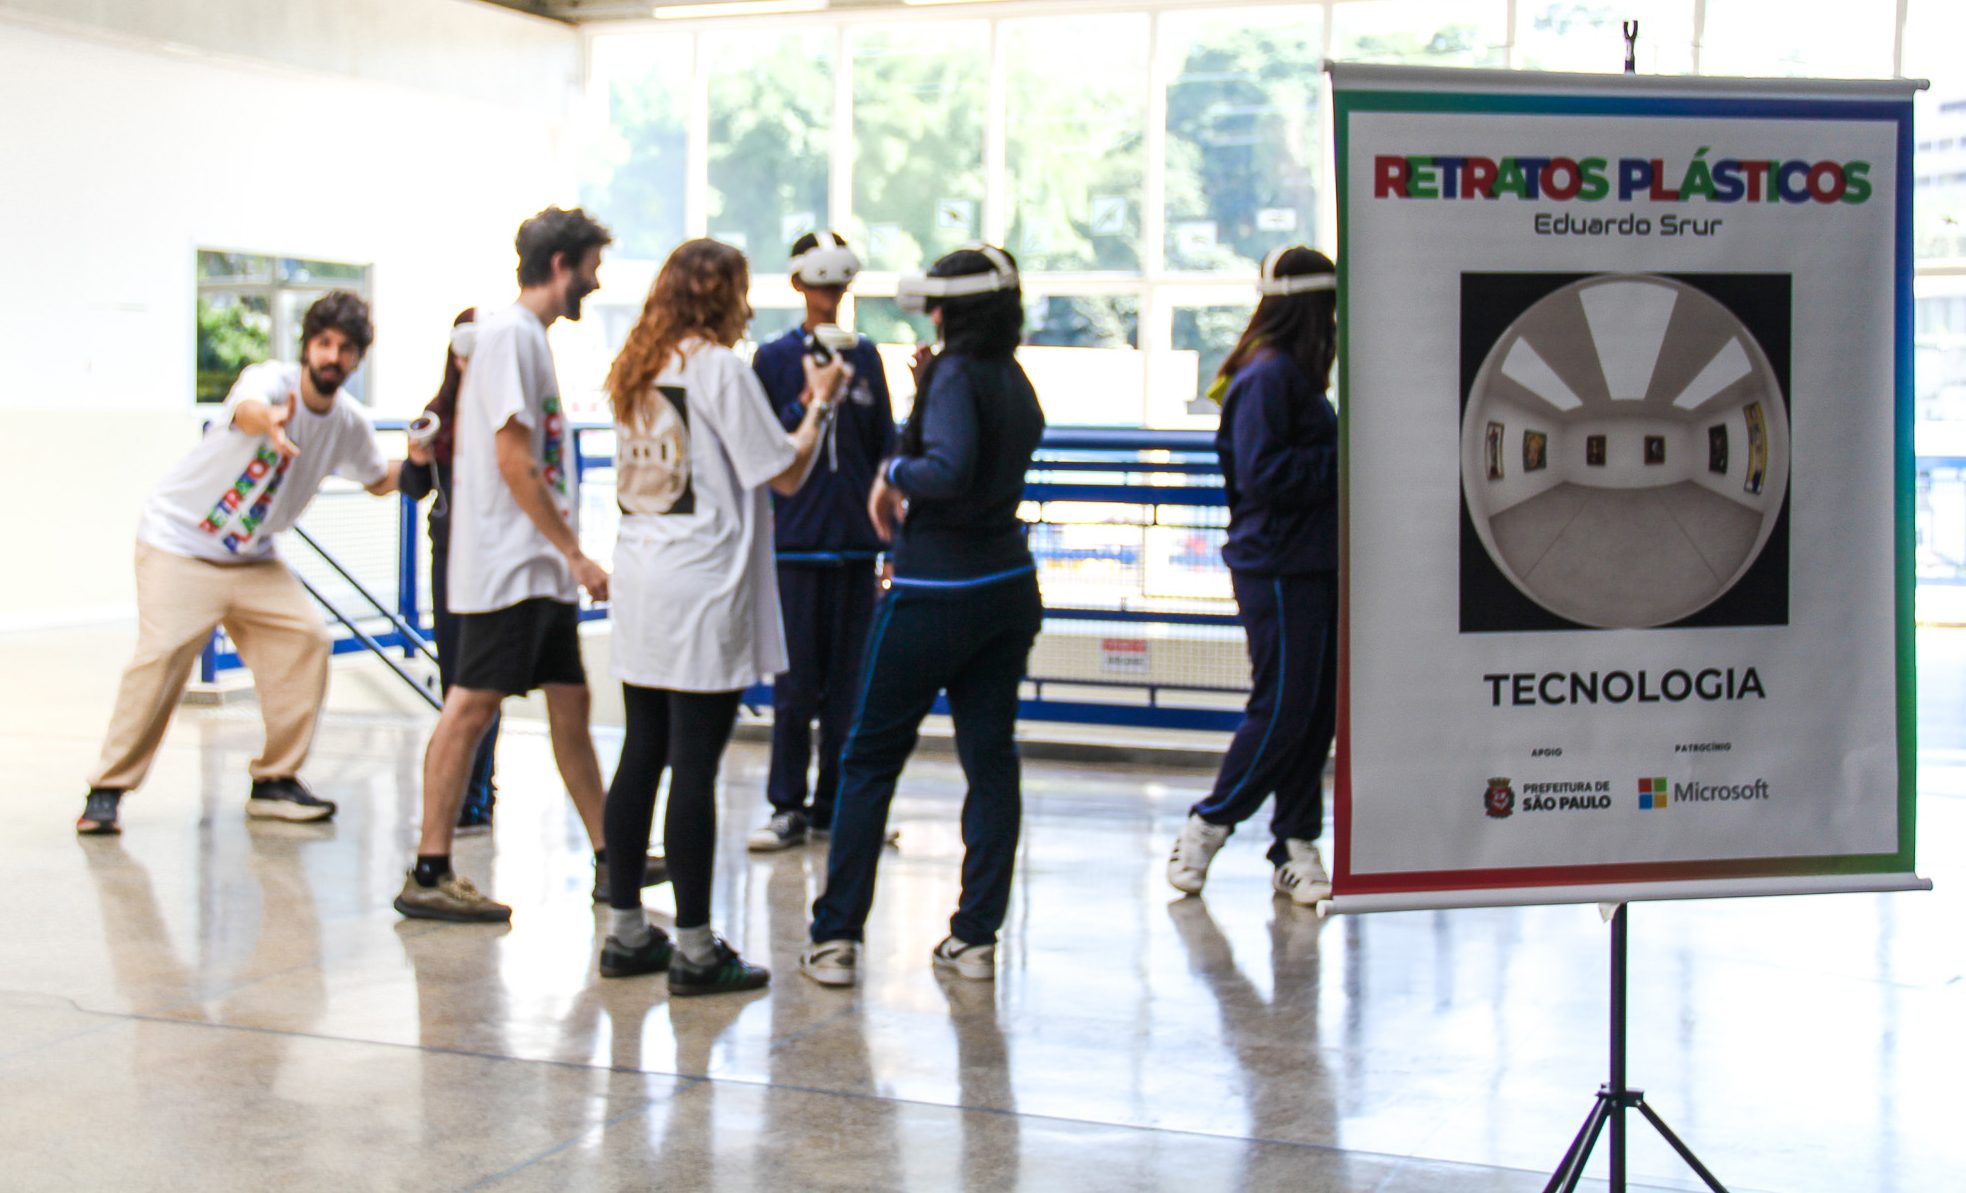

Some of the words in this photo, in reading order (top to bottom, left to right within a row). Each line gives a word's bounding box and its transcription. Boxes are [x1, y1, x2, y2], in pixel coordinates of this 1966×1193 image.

[1374, 155, 1610, 202] RETRATOS
[1618, 146, 1873, 205] PLÁSTICOS
[1534, 212, 1651, 236] Eduardo
[1660, 214, 1723, 236] Srur
[1483, 666, 1766, 707] TECNOLOGIA
[1530, 747, 1563, 758] APOIO
[1522, 782, 1593, 794] PREFEITURA
[1594, 780, 1610, 792] DE
[1674, 778, 1770, 803] Microsoft
[1522, 793, 1557, 812] SÃO
[1559, 795, 1611, 810] PAULO
